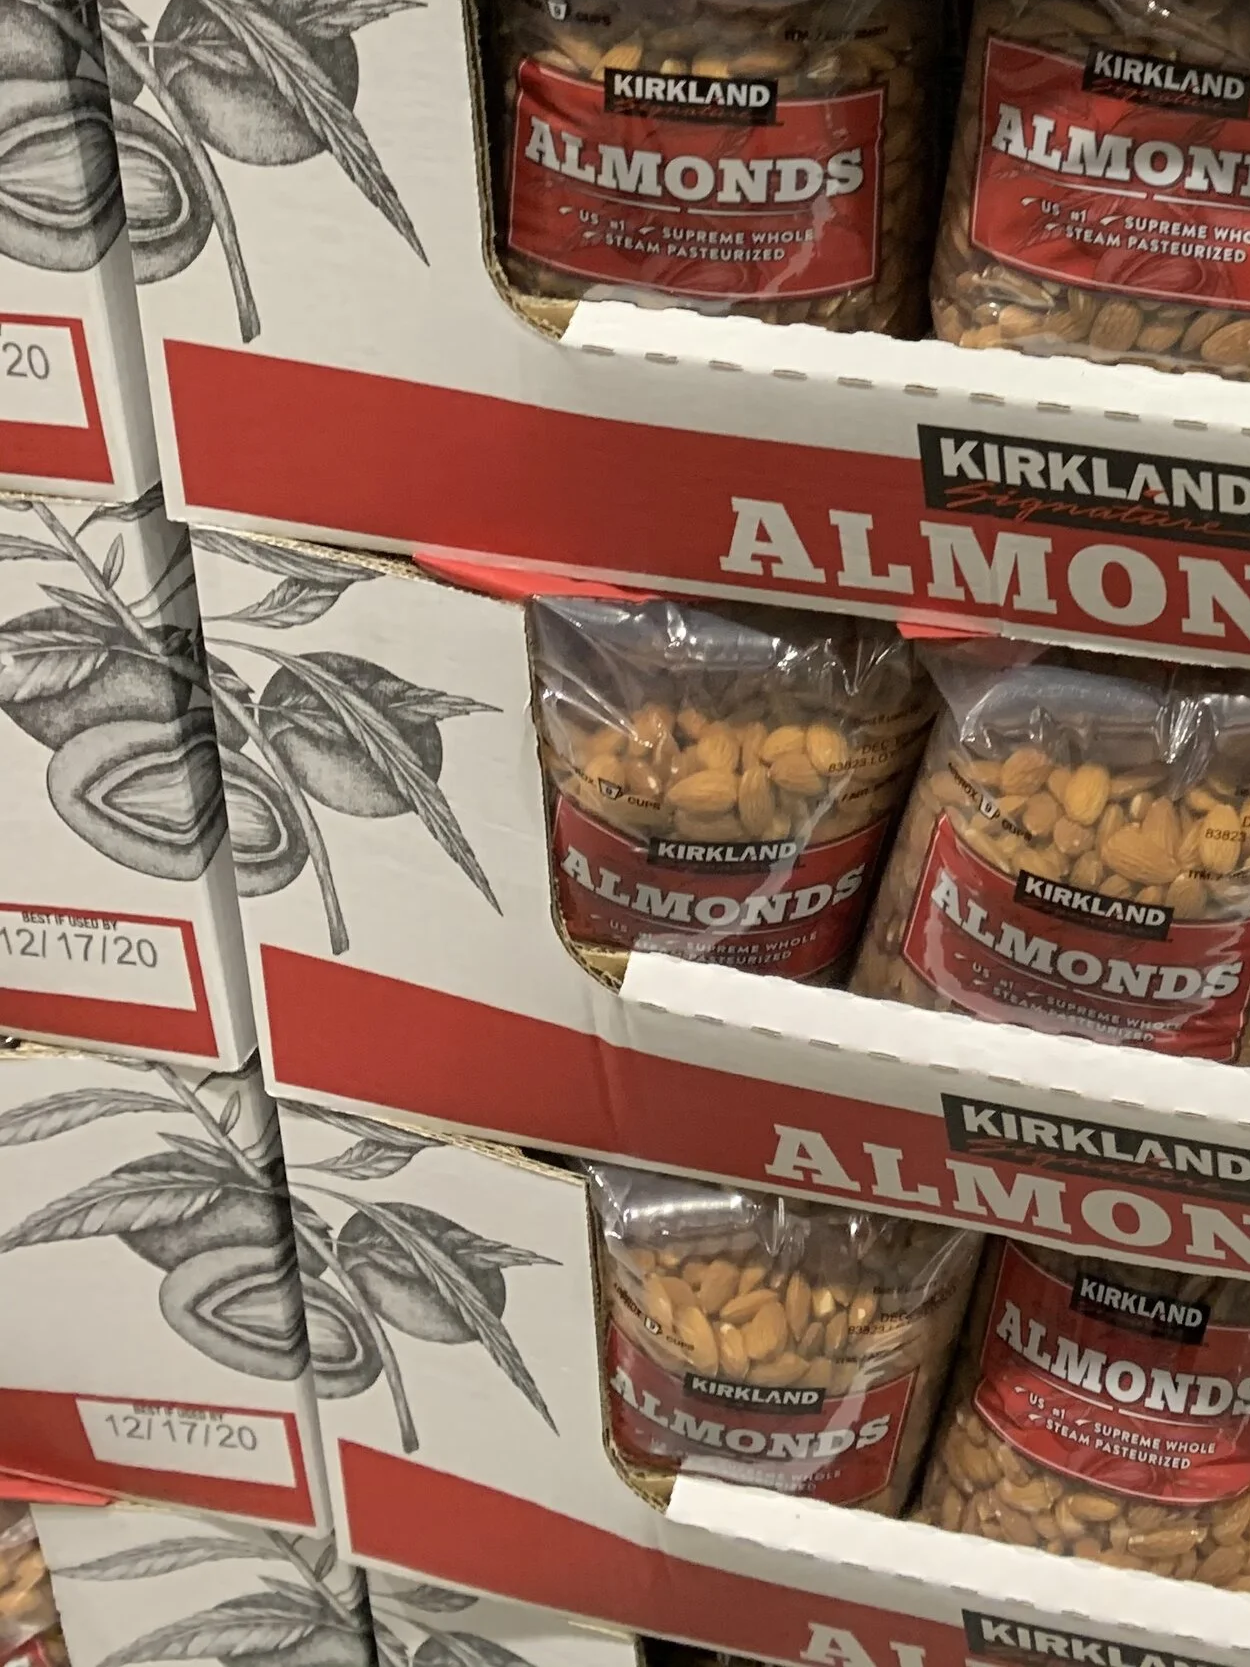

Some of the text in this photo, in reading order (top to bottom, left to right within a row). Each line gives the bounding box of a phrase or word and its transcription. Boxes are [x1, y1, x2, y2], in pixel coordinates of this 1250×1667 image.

[613, 73, 772, 108] KIRKLAND
[1093, 50, 1246, 101] KIRKLAND
[524, 116, 864, 204] ALMONDS
[580, 209, 599, 225] US
[662, 226, 745, 244] SUPREME
[752, 227, 815, 244] WHOLE
[1041, 200, 1061, 217] US
[1123, 215, 1207, 240] SUPREME
[605, 233, 786, 262] STEAM PASTEURIZED
[1065, 225, 1247, 264] STEAM PASTEURIZED
[657, 841, 797, 863] KIRKLAND
[560, 845, 866, 927] ALMONDS
[1023, 876, 1166, 926] KIRKLAND
[21, 910, 119, 931] BEST IF USED BY
[931, 869, 1242, 1002] ALMONDS
[0, 926, 158, 968] 12/17/20
[766, 931, 818, 952] WHOLE
[972, 961, 990, 979] US
[1047, 995, 1120, 1025] SUPREME
[992, 986, 1043, 1014] STEAM
[1080, 1277, 1203, 1328] KIRKLAND
[692, 1376, 820, 1406] KIRKLAND
[104, 1413, 258, 1451] 12/17/20
[611, 1365, 892, 1459] ALMONDS
[1028, 1392, 1045, 1410] US
[1094, 1422, 1161, 1450] SUPREME
[1166, 1440, 1216, 1454] WHOLE
[1046, 1419, 1191, 1470] STEAM PASTEURIZED
